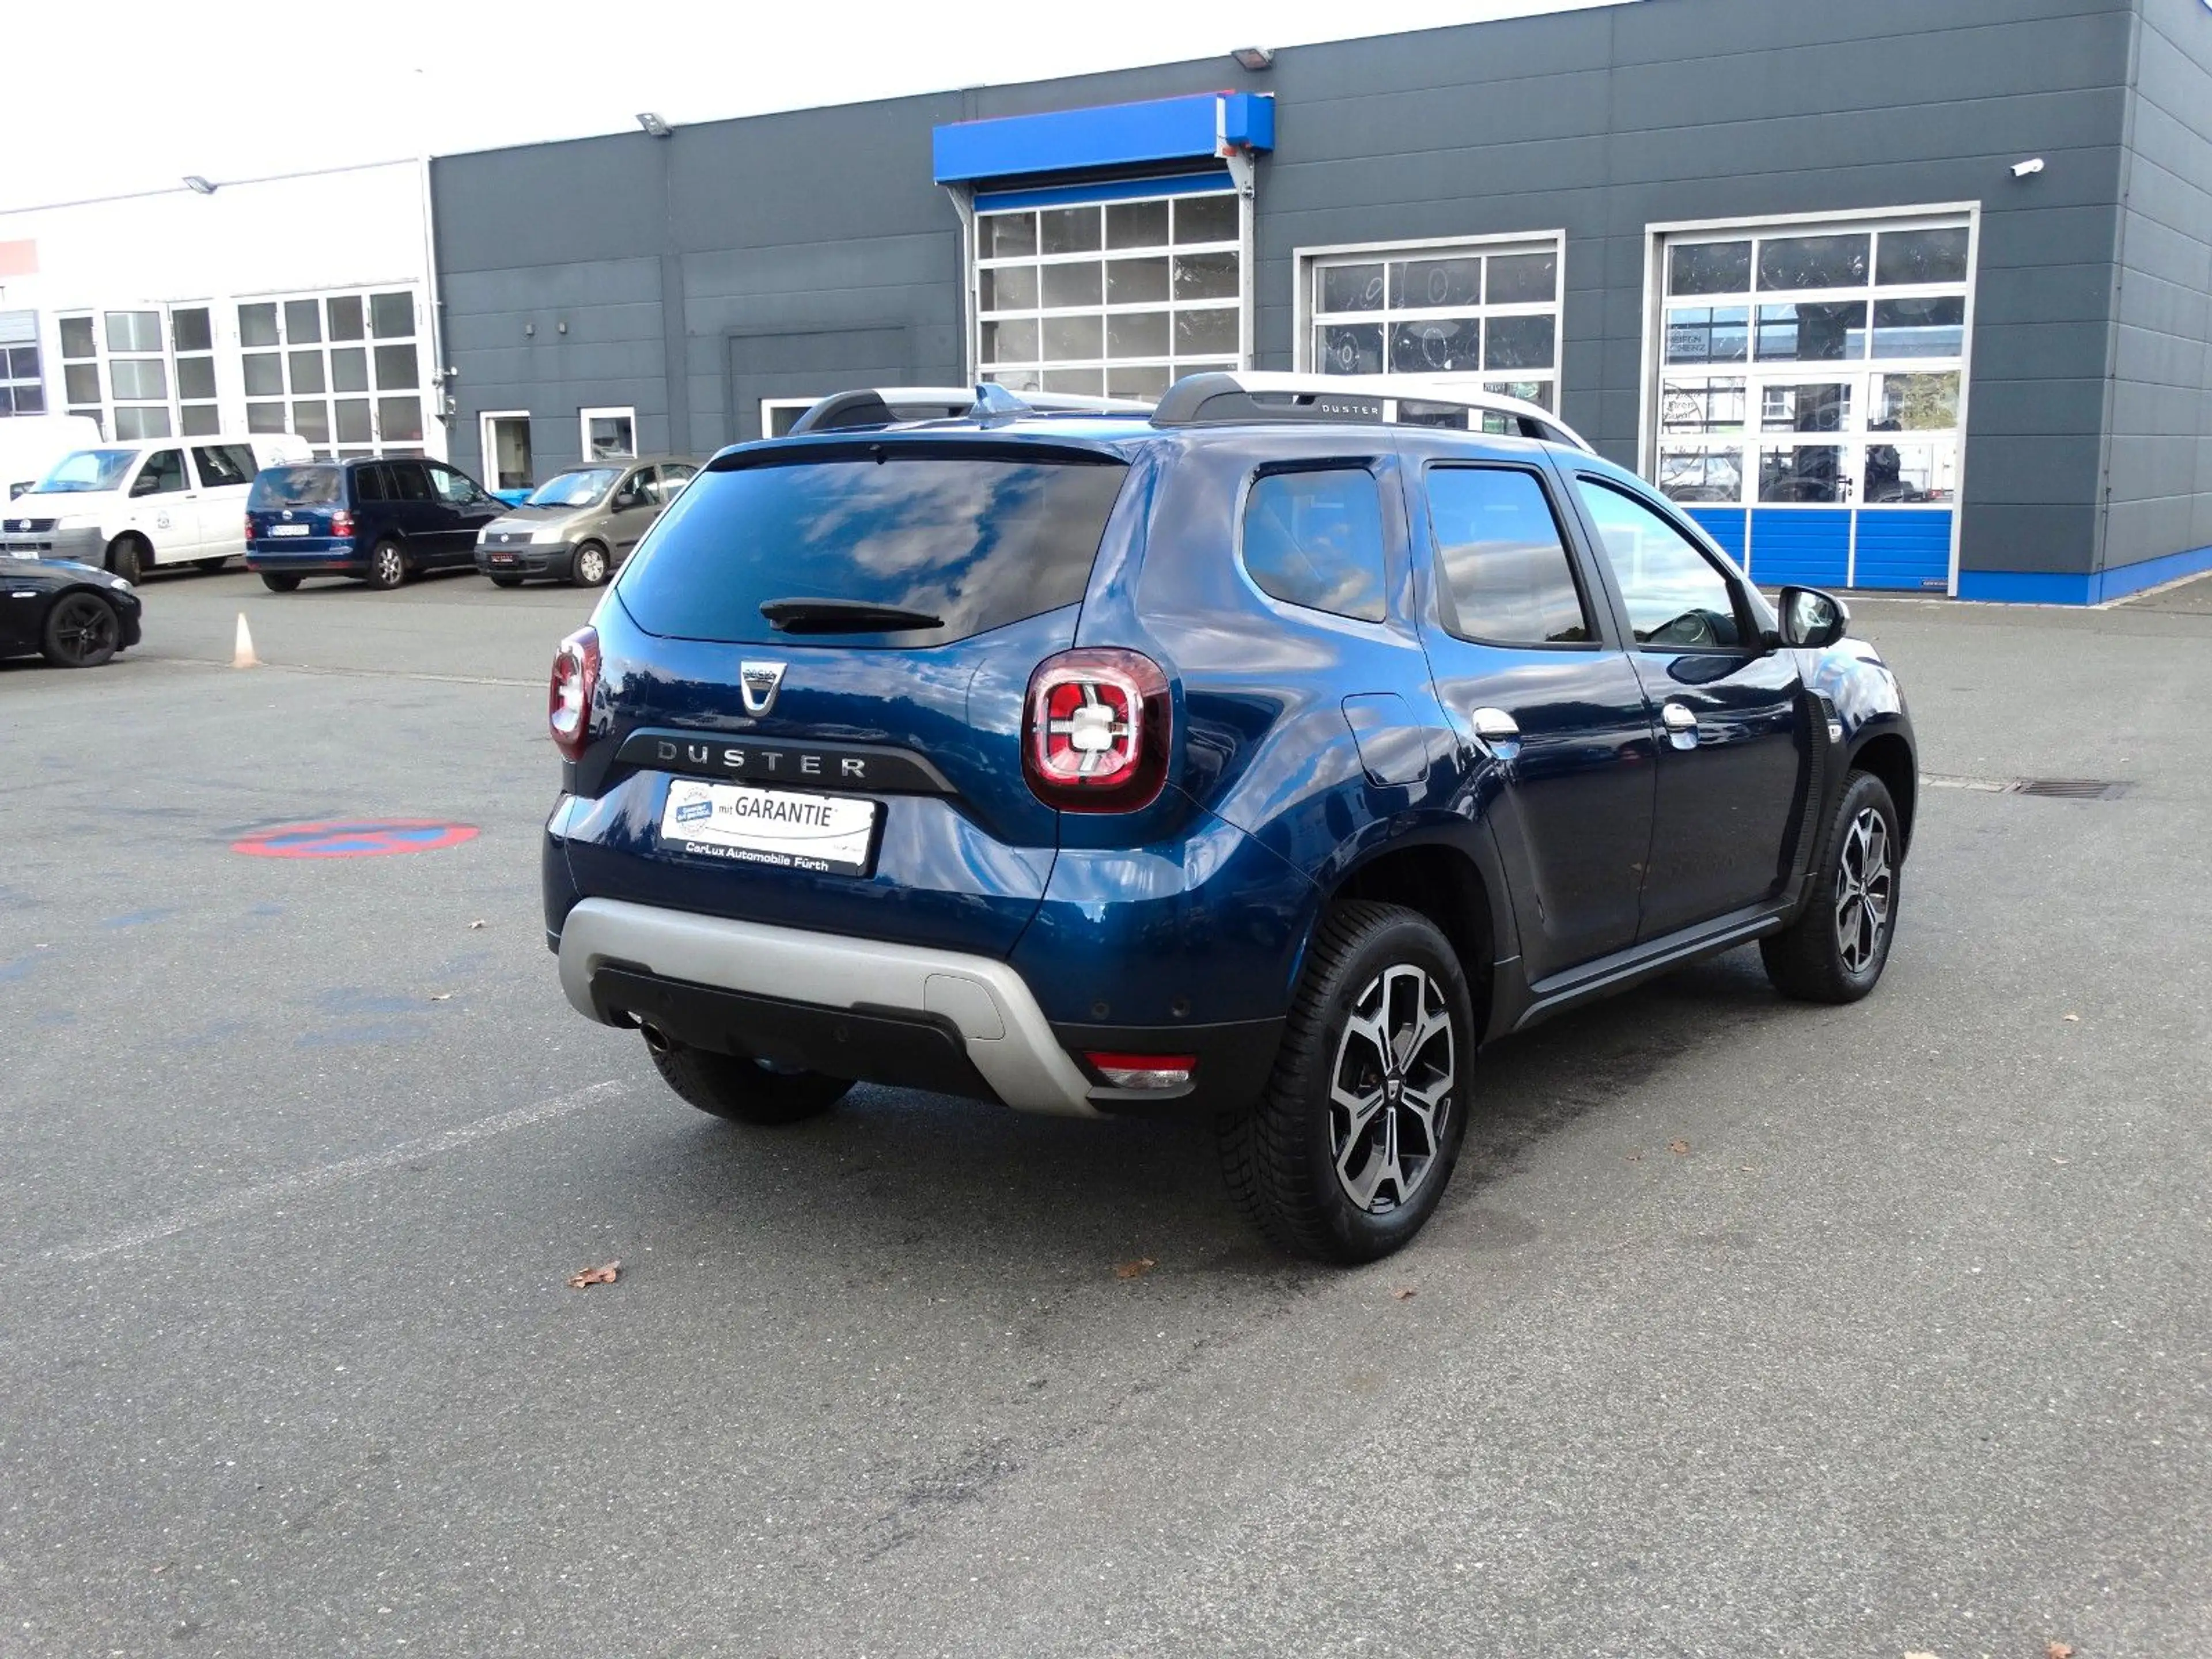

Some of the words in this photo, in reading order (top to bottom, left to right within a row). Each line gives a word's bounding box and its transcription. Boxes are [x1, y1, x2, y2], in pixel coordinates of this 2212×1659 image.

[1321, 405, 1378, 414] DUSTER
[658, 740, 866, 778] DUSTER
[718, 805, 733, 815] mit
[736, 796, 832, 827] GARANTIE
[685, 842, 725, 857] CarLux
[726, 847, 790, 865] Automobile
[794, 857, 830, 872] Fürth
